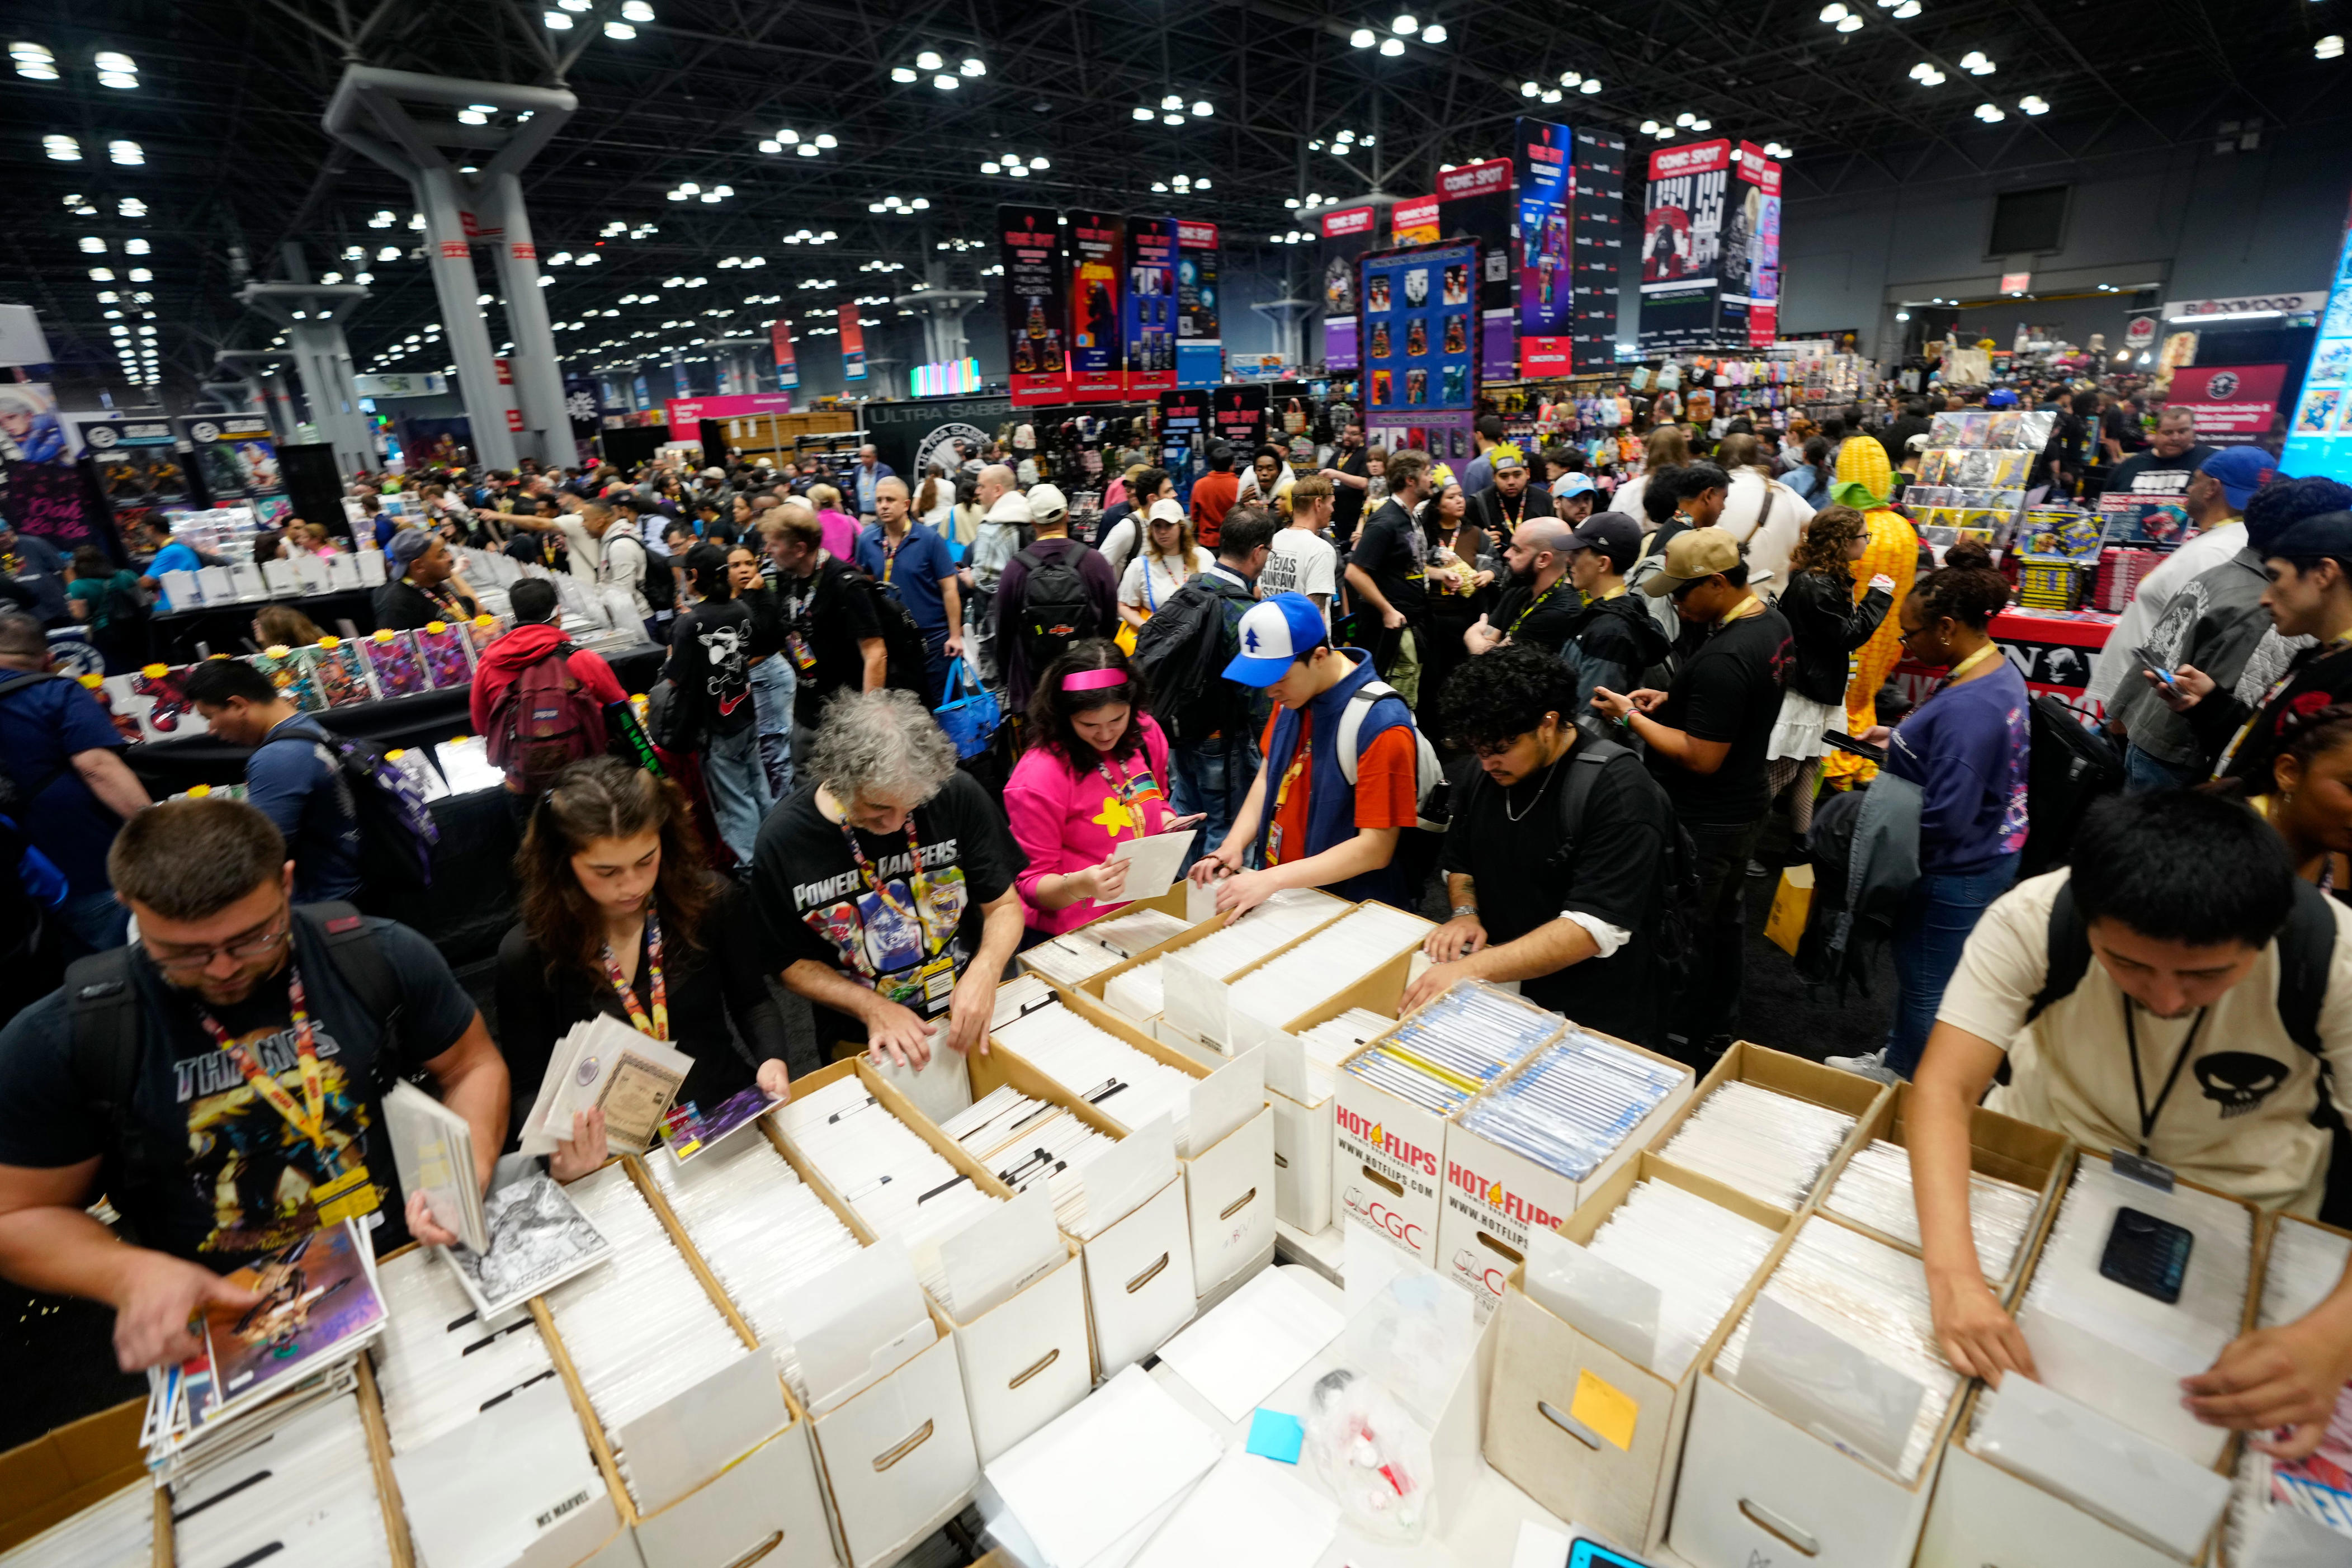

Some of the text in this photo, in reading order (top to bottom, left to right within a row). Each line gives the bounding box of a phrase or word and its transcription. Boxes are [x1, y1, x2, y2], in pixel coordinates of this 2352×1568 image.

[1657, 152, 1690, 169] COMIC
[1690, 145, 1722, 164] SPOT
[1444, 166, 1504, 191] COMIC SPOT
[1420, 204, 1439, 218] SPO
[870, 406, 944, 424] ULTRA
[1261, 570, 1297, 589] AINSAW
[792, 868, 861, 913] POWER
[1336, 1104, 1437, 1176] HOT FLIPS
[1338, 1137, 1433, 1199] WWW.HOTFLIPS.COM
[1448, 1160, 1490, 1201] HOT
[1369, 1202, 1423, 1250] CGC
[1449, 1195, 1529, 1250] WWW.HOTFLIPS
[536, 1490, 589, 1528] MS MARVEL
